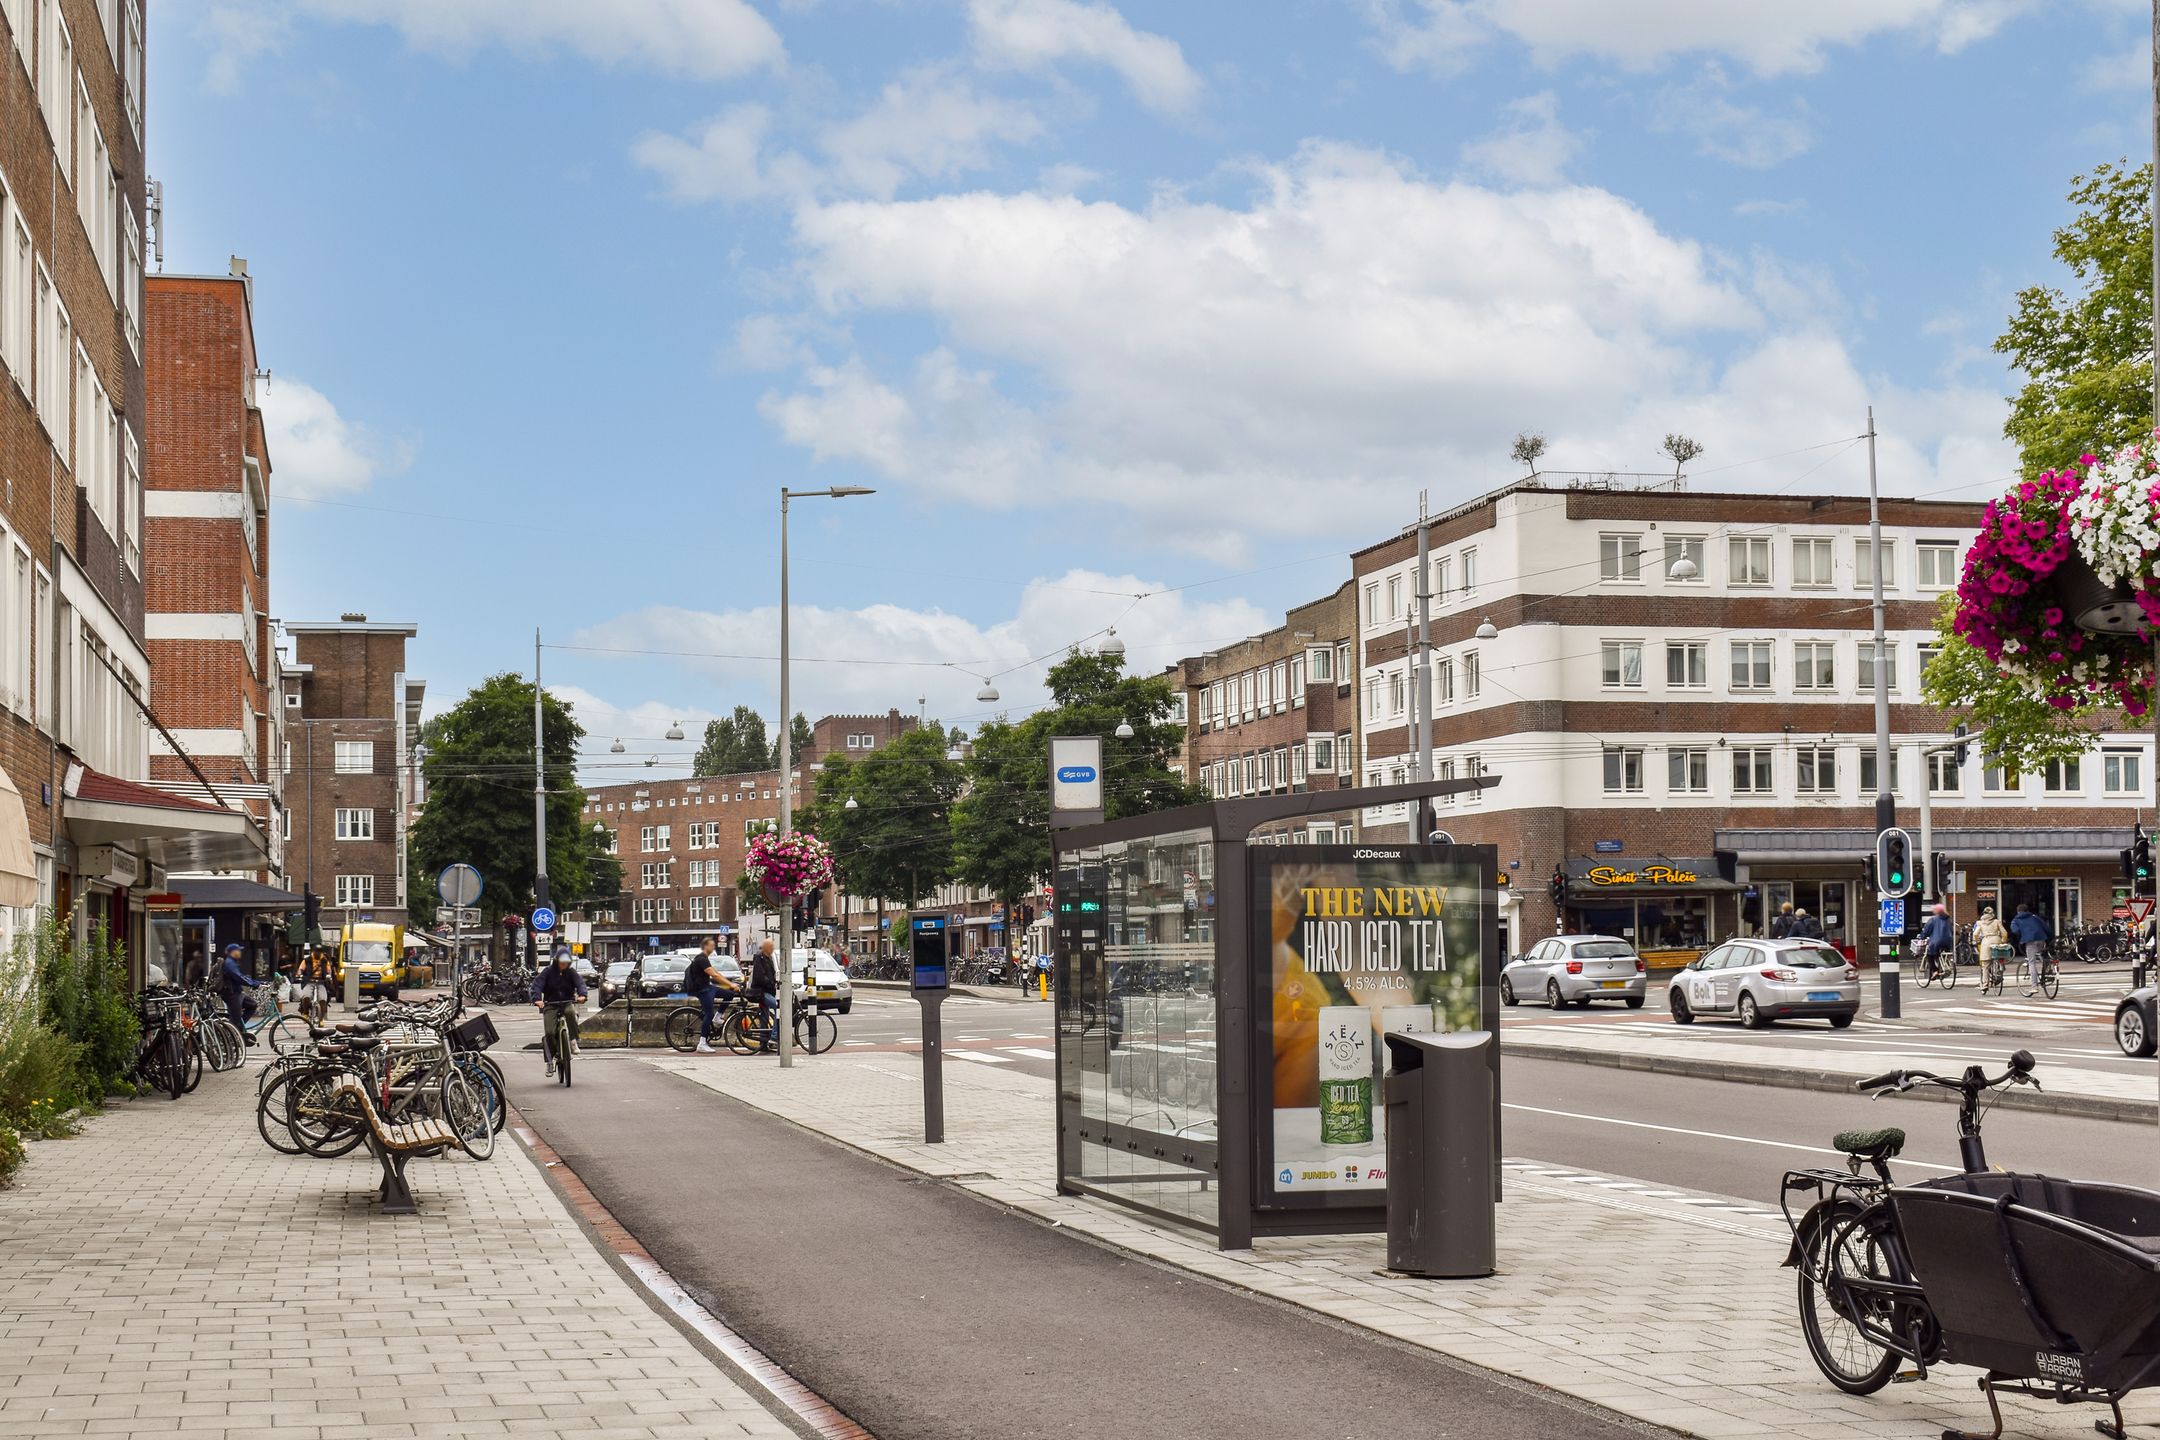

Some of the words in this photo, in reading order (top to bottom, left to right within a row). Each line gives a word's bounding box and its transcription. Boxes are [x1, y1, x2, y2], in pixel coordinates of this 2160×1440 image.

[1353, 849, 1400, 859] JCDecaux
[1590, 866, 1637, 885] Simit
[1301, 887, 1364, 916] THE
[1373, 886, 1448, 916] NEW
[1303, 920, 1353, 973] HARD
[1360, 920, 1401, 972] ICED
[1409, 920, 1447, 971] TEA
[1343, 976, 1376, 991] 4.5%
[1379, 976, 1409, 990] ALC.
[1694, 982, 1711, 999] Bolt
[1325, 1024, 1365, 1051] STËLZ
[1330, 1085, 1345, 1103] ICED
[1346, 1085, 1360, 1102] TEA
[1329, 1102, 1360, 1114] Lemon
[1301, 1171, 1337, 1180] JUMBO
[2044, 1353, 2081, 1368] URBAN
[2047, 1363, 2081, 1378] ARROW
